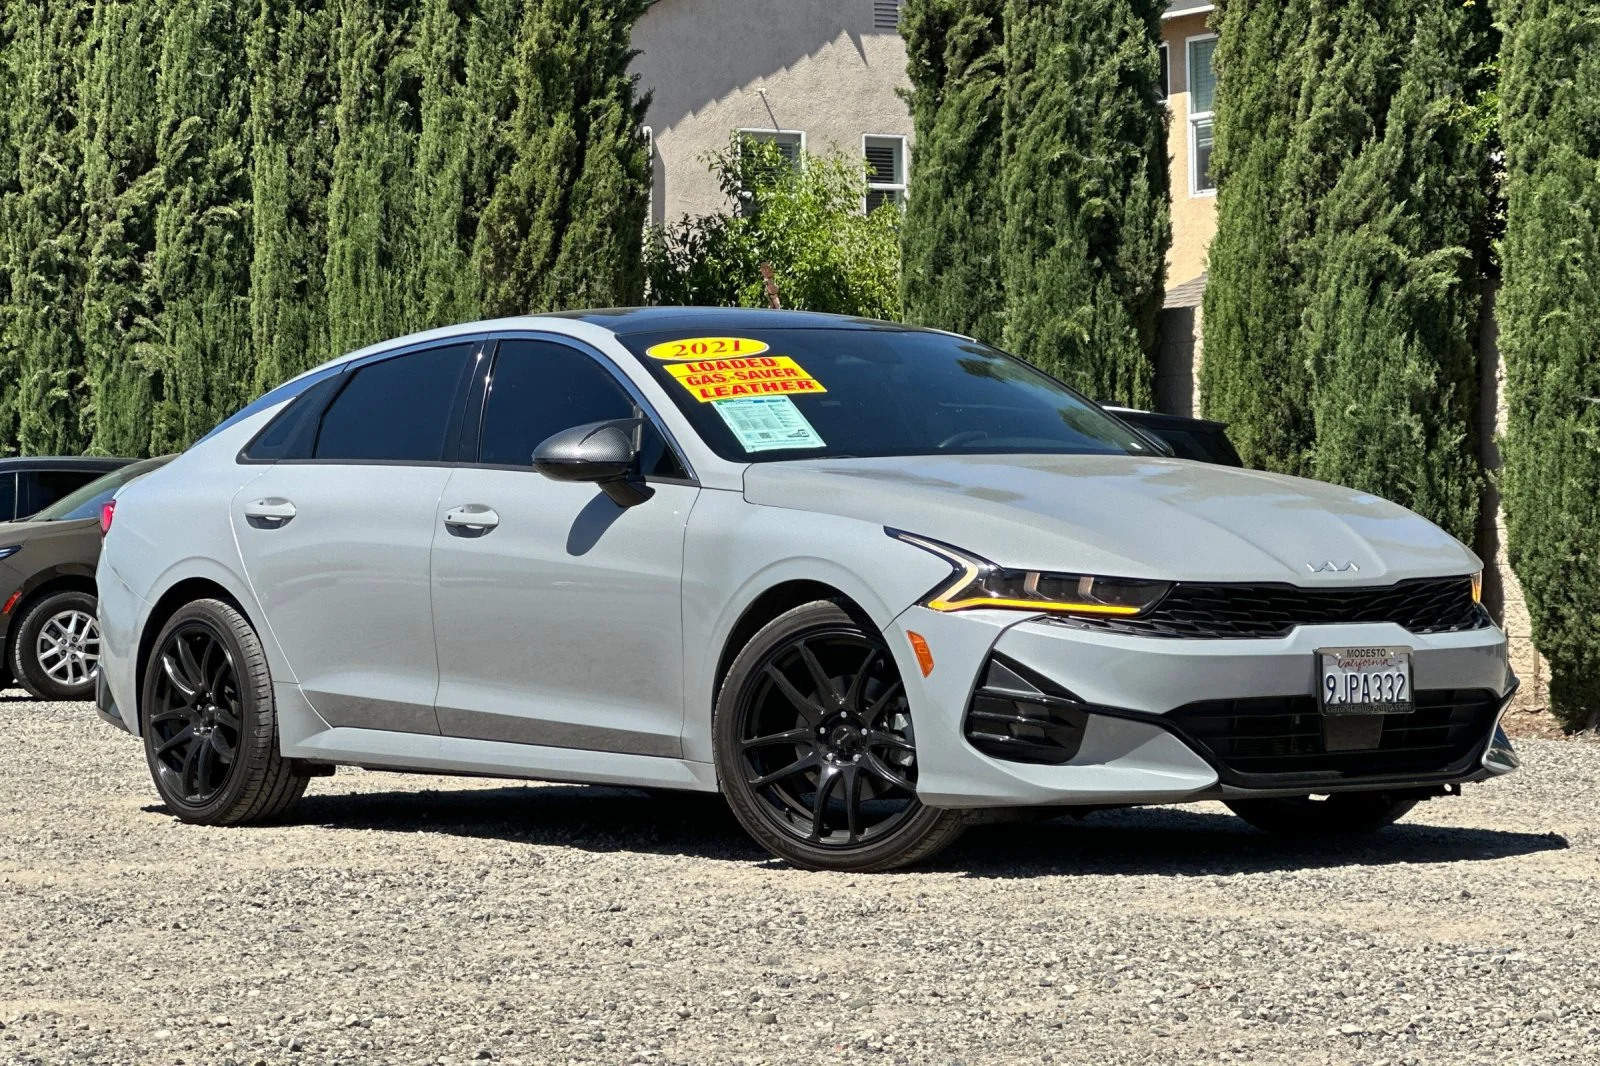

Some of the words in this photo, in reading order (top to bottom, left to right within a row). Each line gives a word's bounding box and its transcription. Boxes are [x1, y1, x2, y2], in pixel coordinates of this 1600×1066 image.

[672, 340, 742, 357] 2021
[686, 357, 777, 373] LOADED
[686, 368, 798, 386] GAS-SAVER
[699, 381, 814, 398] LEATHER
[1346, 648, 1386, 658] MODESTO
[1337, 658, 1394, 672] California
[1325, 673, 1407, 704] 9JPA332
